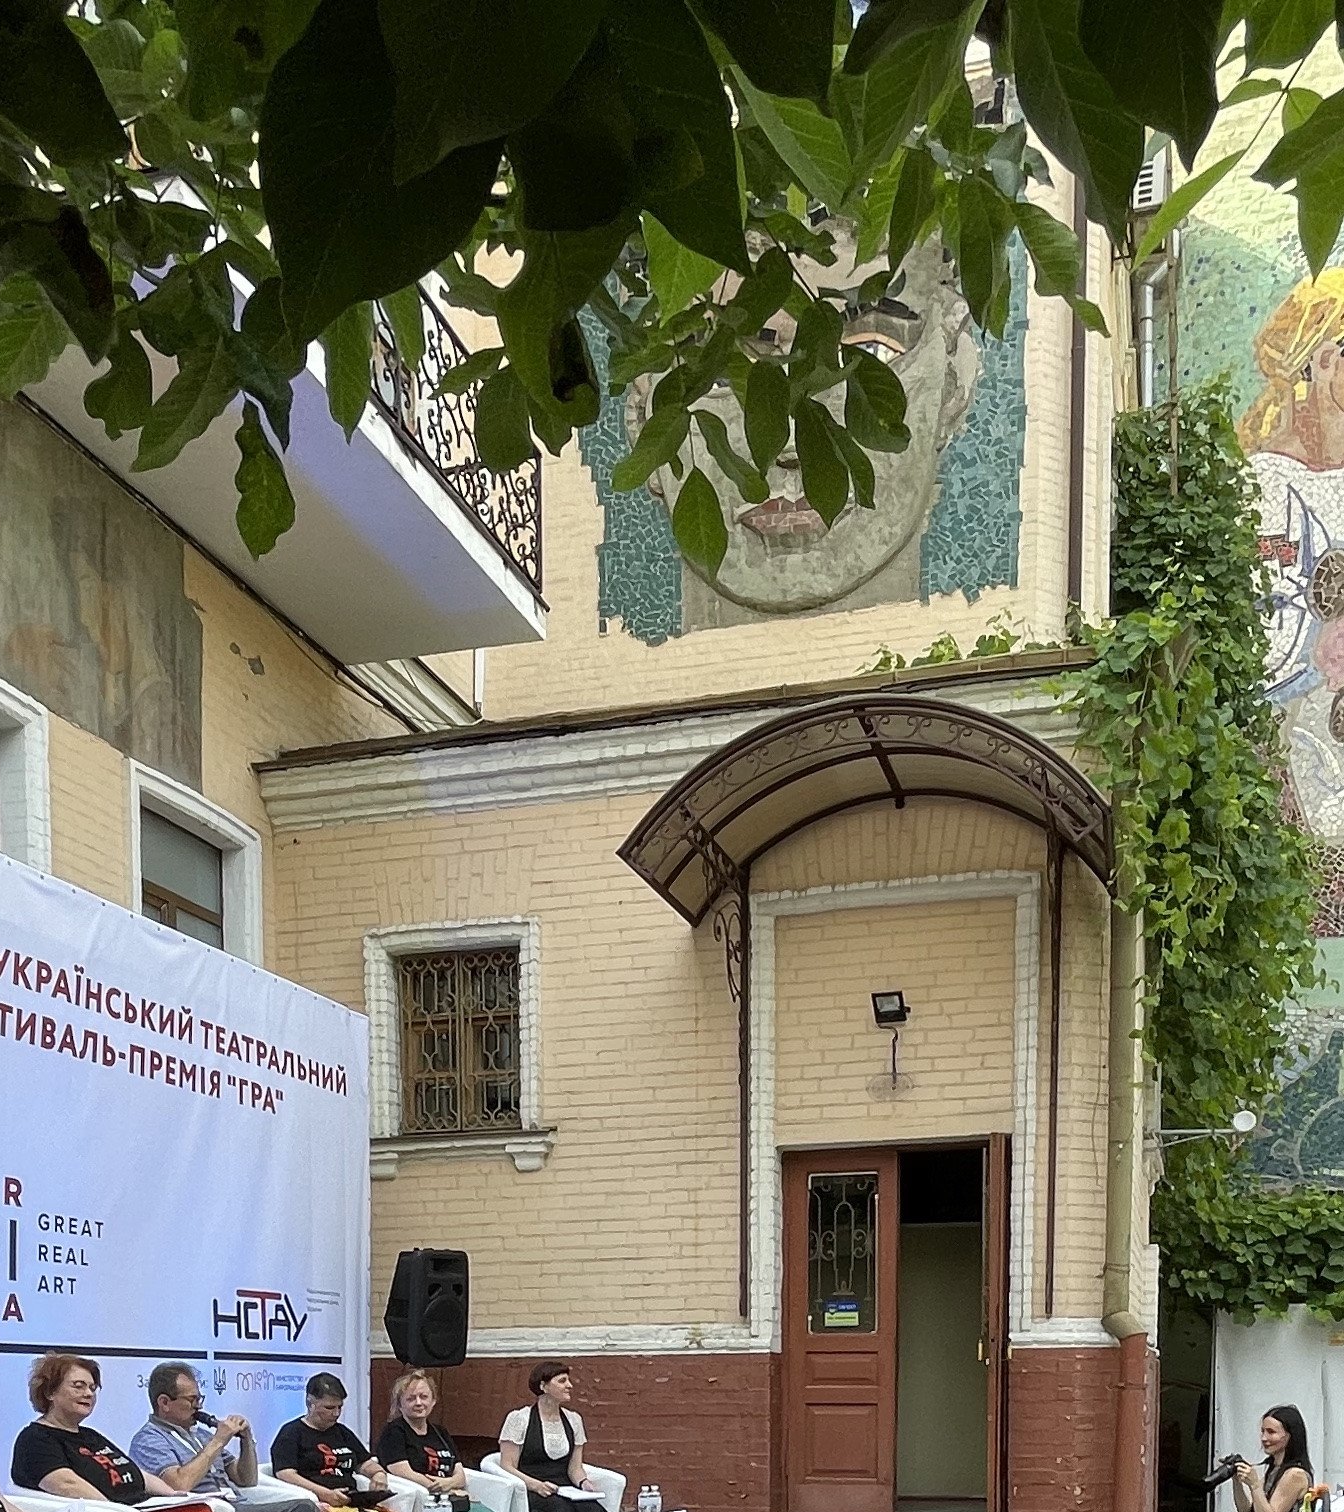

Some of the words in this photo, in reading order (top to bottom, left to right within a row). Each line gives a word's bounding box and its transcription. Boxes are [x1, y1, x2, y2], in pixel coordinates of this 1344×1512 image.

[199, 1021, 348, 1096] ТЕАТРАЛЬНИЙ
[227, 1075, 284, 1115] "ГРА"
[37, 1213, 104, 1239] GREAT
[37, 1244, 89, 1266] REAL
[37, 1275, 77, 1295] ART
